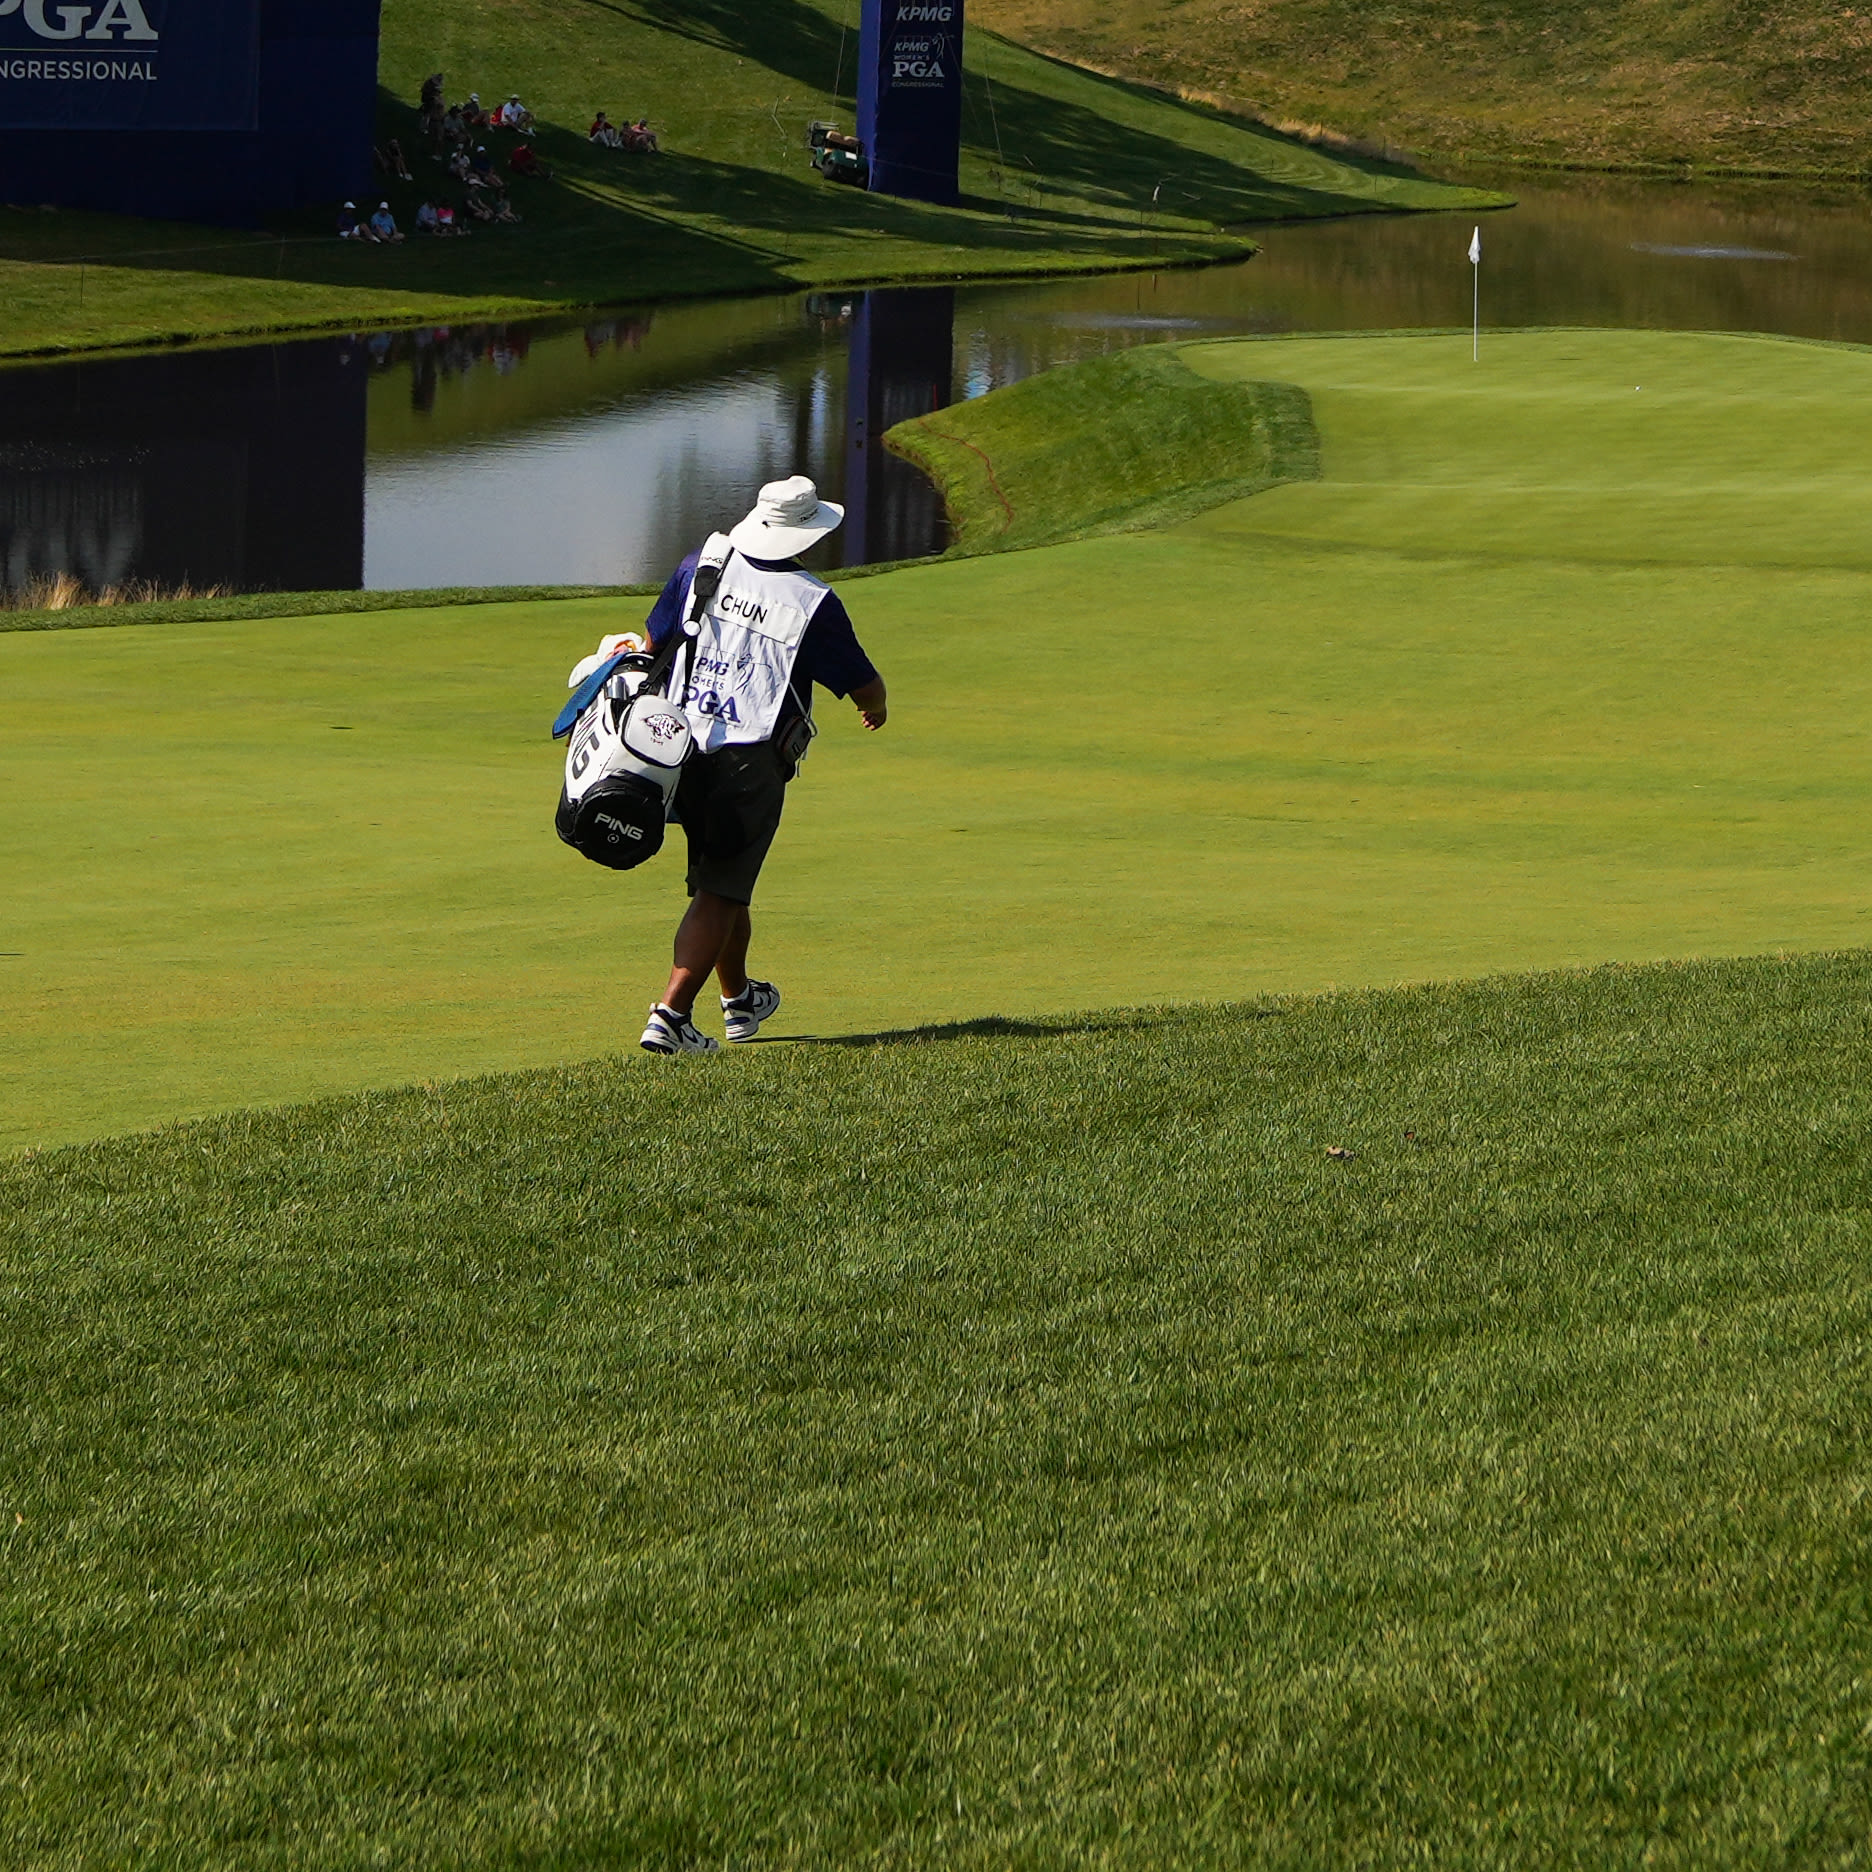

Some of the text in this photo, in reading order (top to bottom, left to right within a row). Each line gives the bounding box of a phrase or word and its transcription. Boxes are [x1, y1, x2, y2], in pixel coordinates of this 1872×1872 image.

[895, 6, 953, 22] KPMG
[894, 41, 930, 53] KPMG
[892, 61, 945, 78] PGA
[720, 593, 768, 625] CHUN
[594, 812, 645, 841] PING
